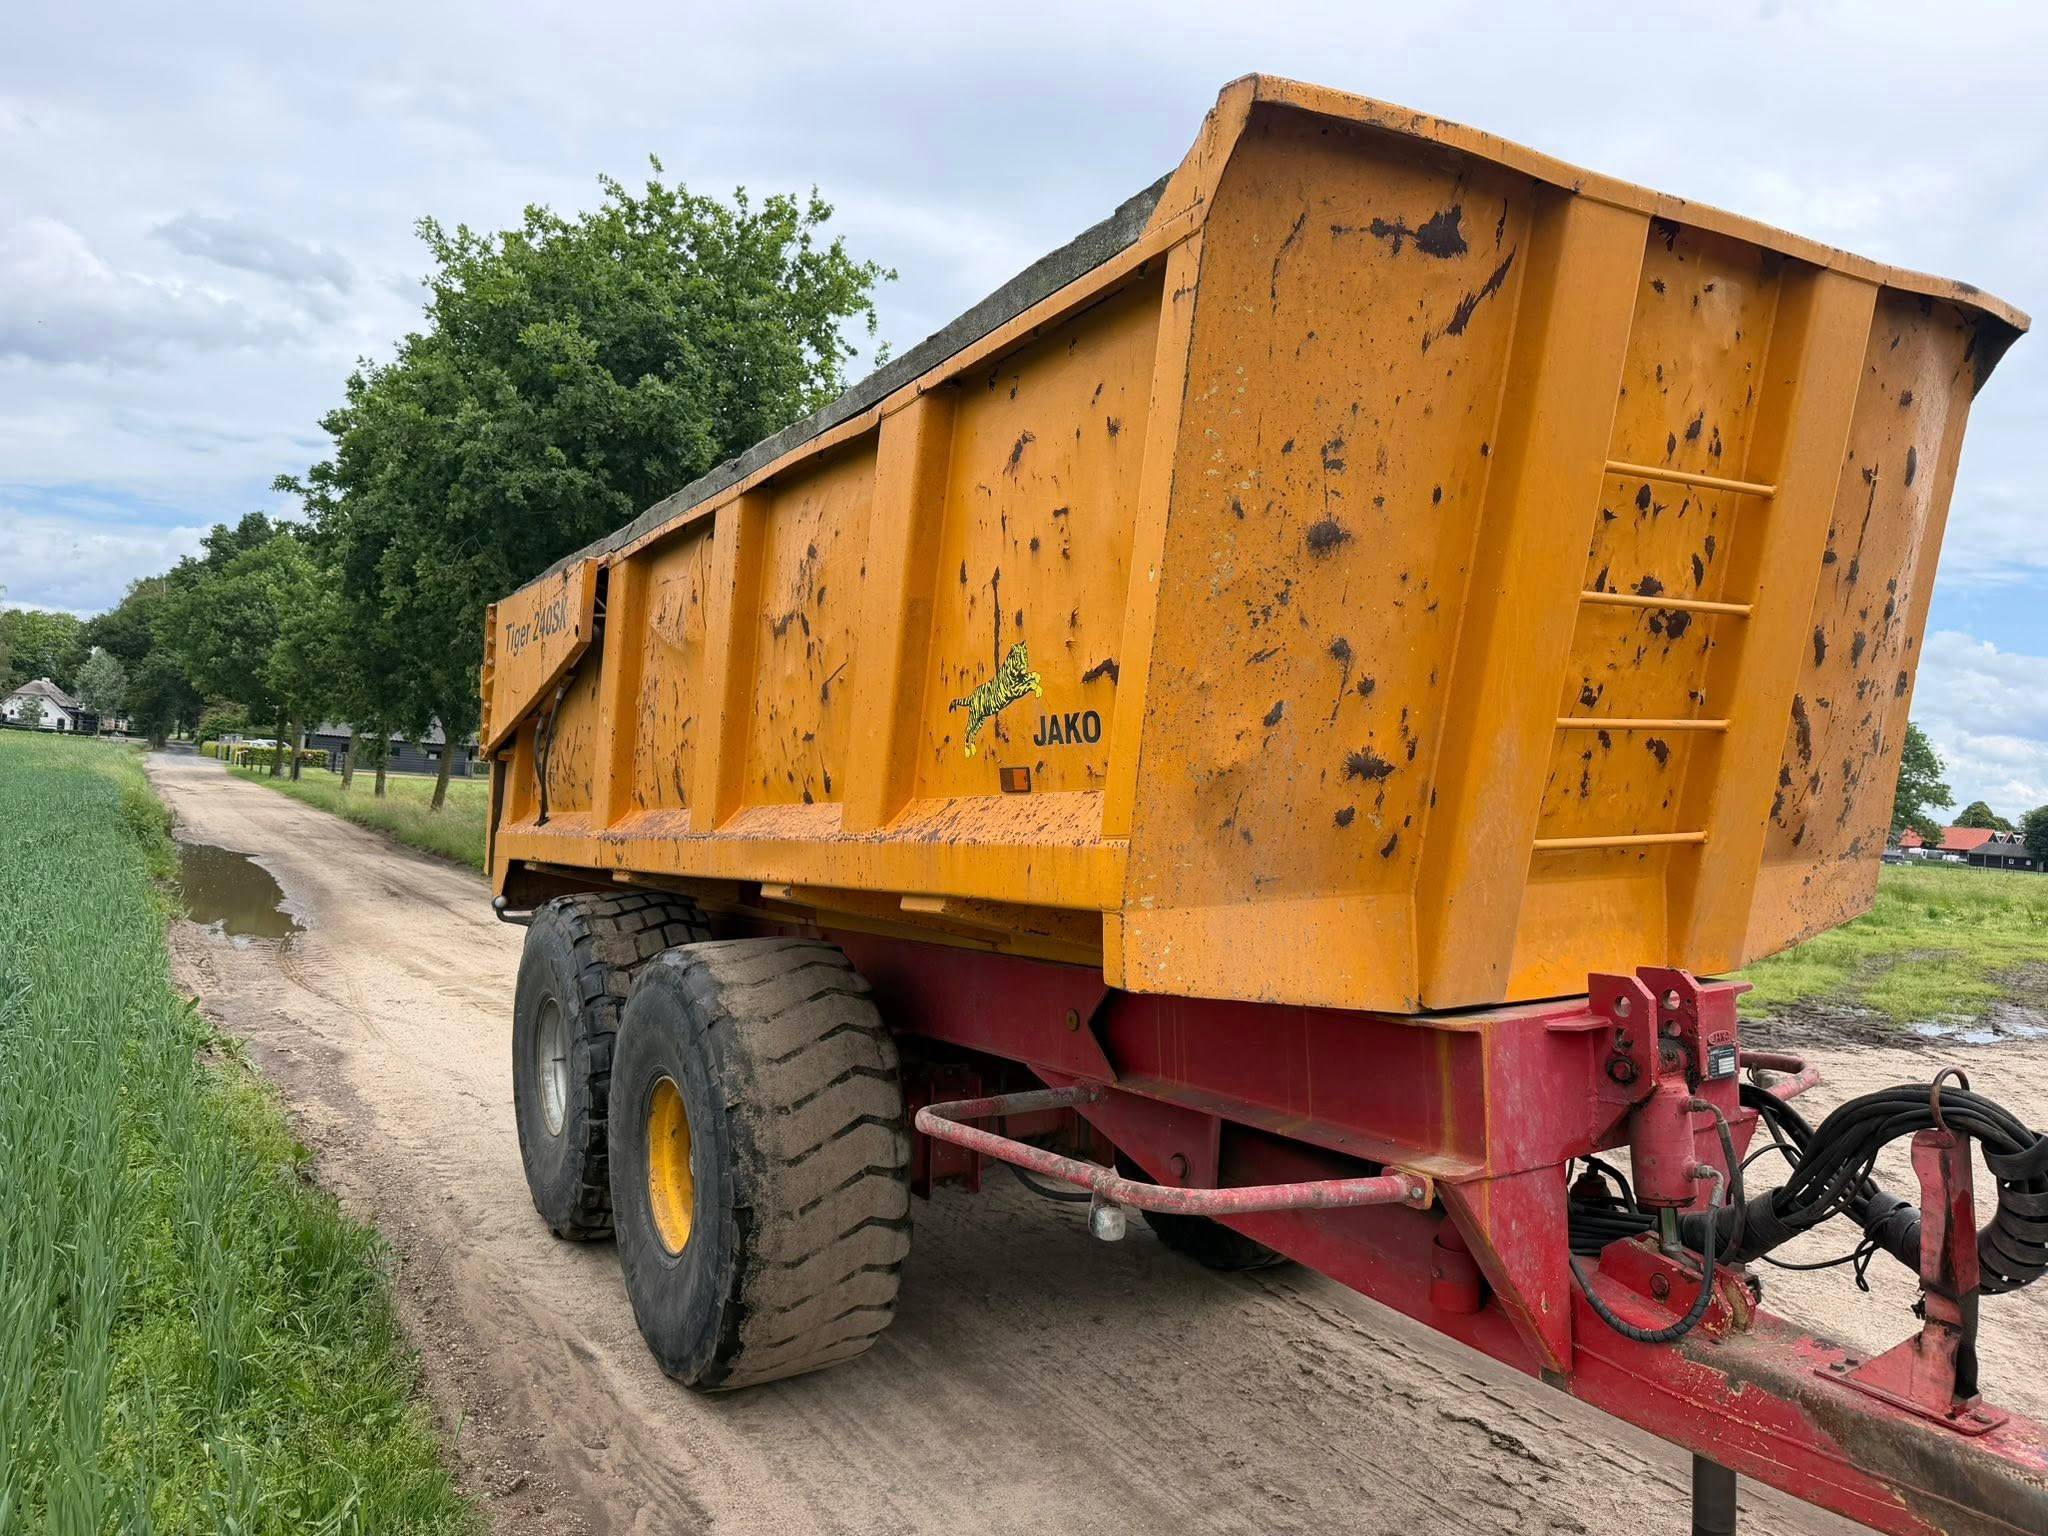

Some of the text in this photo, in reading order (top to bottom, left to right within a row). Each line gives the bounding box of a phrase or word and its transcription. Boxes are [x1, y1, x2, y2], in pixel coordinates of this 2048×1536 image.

[505, 596, 569, 657] Tiger 240SK
[1033, 710, 1102, 746] JAKO
